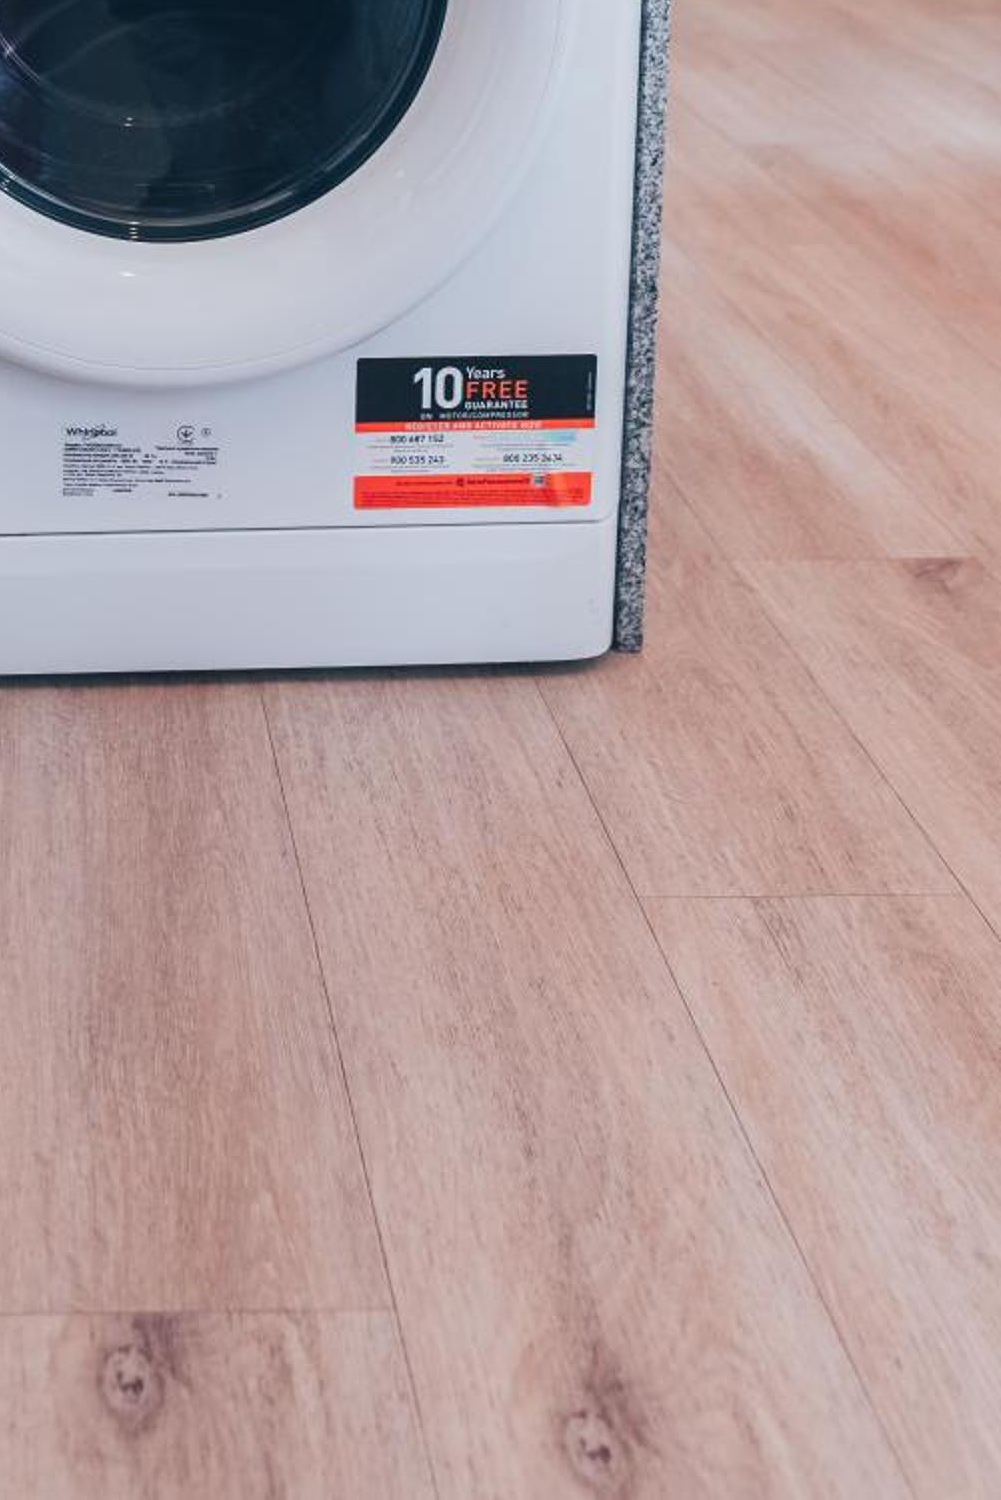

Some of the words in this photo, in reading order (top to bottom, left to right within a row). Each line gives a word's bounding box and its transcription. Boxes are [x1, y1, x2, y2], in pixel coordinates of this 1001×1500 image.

[466, 366, 505, 379] Years
[413, 365, 463, 409] 10
[466, 380, 528, 399] FREE
[465, 399, 528, 410] GUARANTEE
